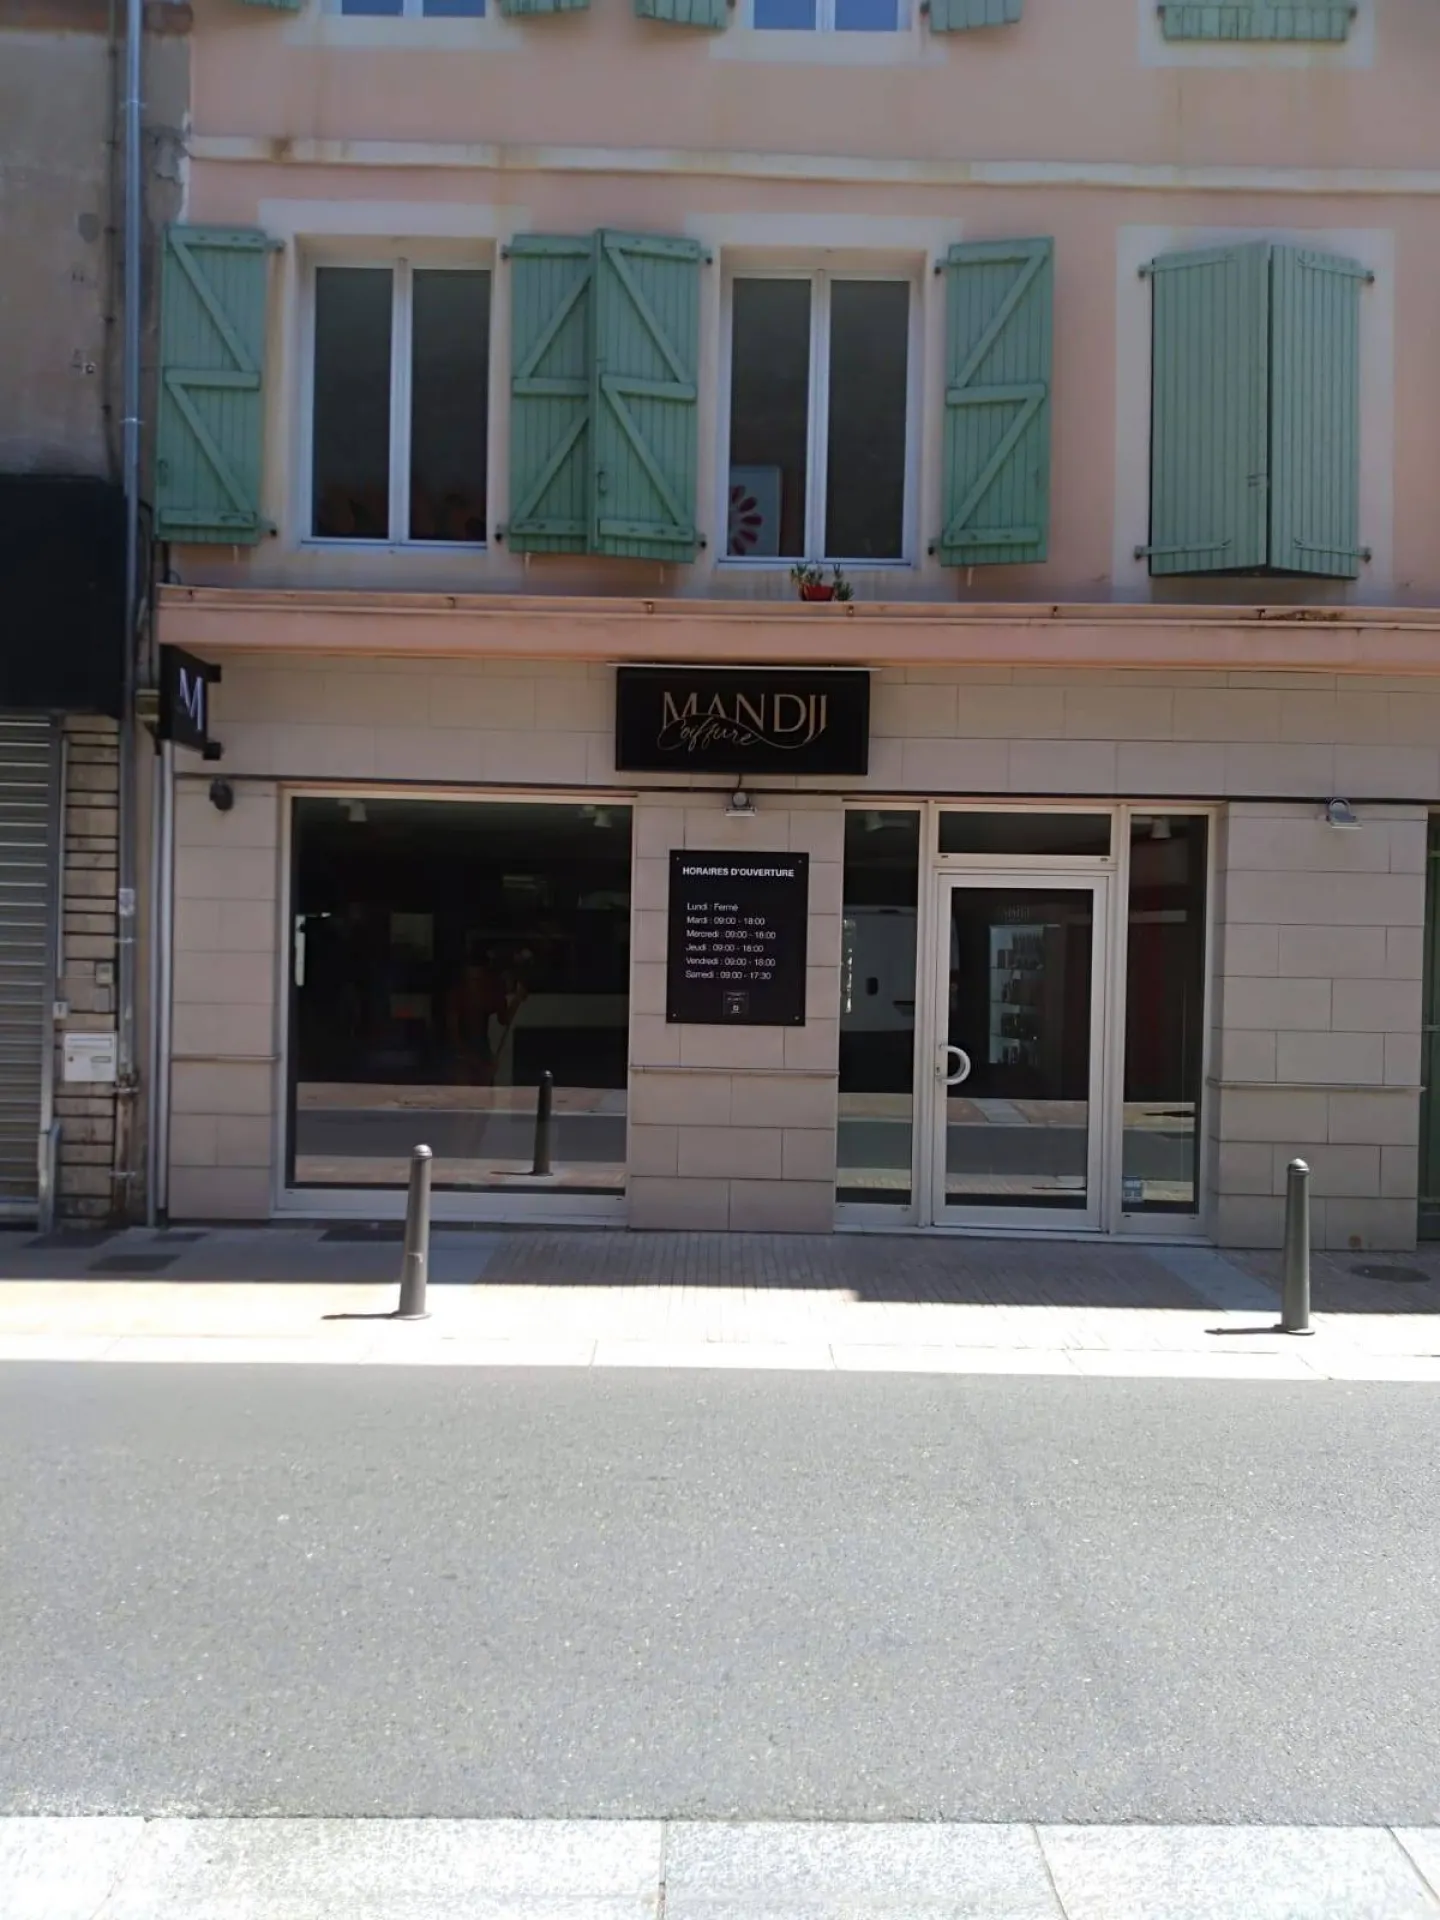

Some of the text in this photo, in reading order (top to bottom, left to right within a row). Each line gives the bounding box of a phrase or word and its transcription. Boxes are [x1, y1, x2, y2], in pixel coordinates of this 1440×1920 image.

[179, 667, 203, 730] M
[662, 691, 828, 741] MANDJI
[656, 714, 760, 753] Coiffure
[682, 866, 795, 877] HORAIRES D'OUVERTURE
[687, 902, 708, 911] Lundi
[687, 916, 708, 924] Mardi
[686, 929, 719, 938] Mercredi
[686, 943, 707, 951] Jeudi
[685, 957, 719, 965] Vendredi
[685, 970, 714, 978] Samedi
